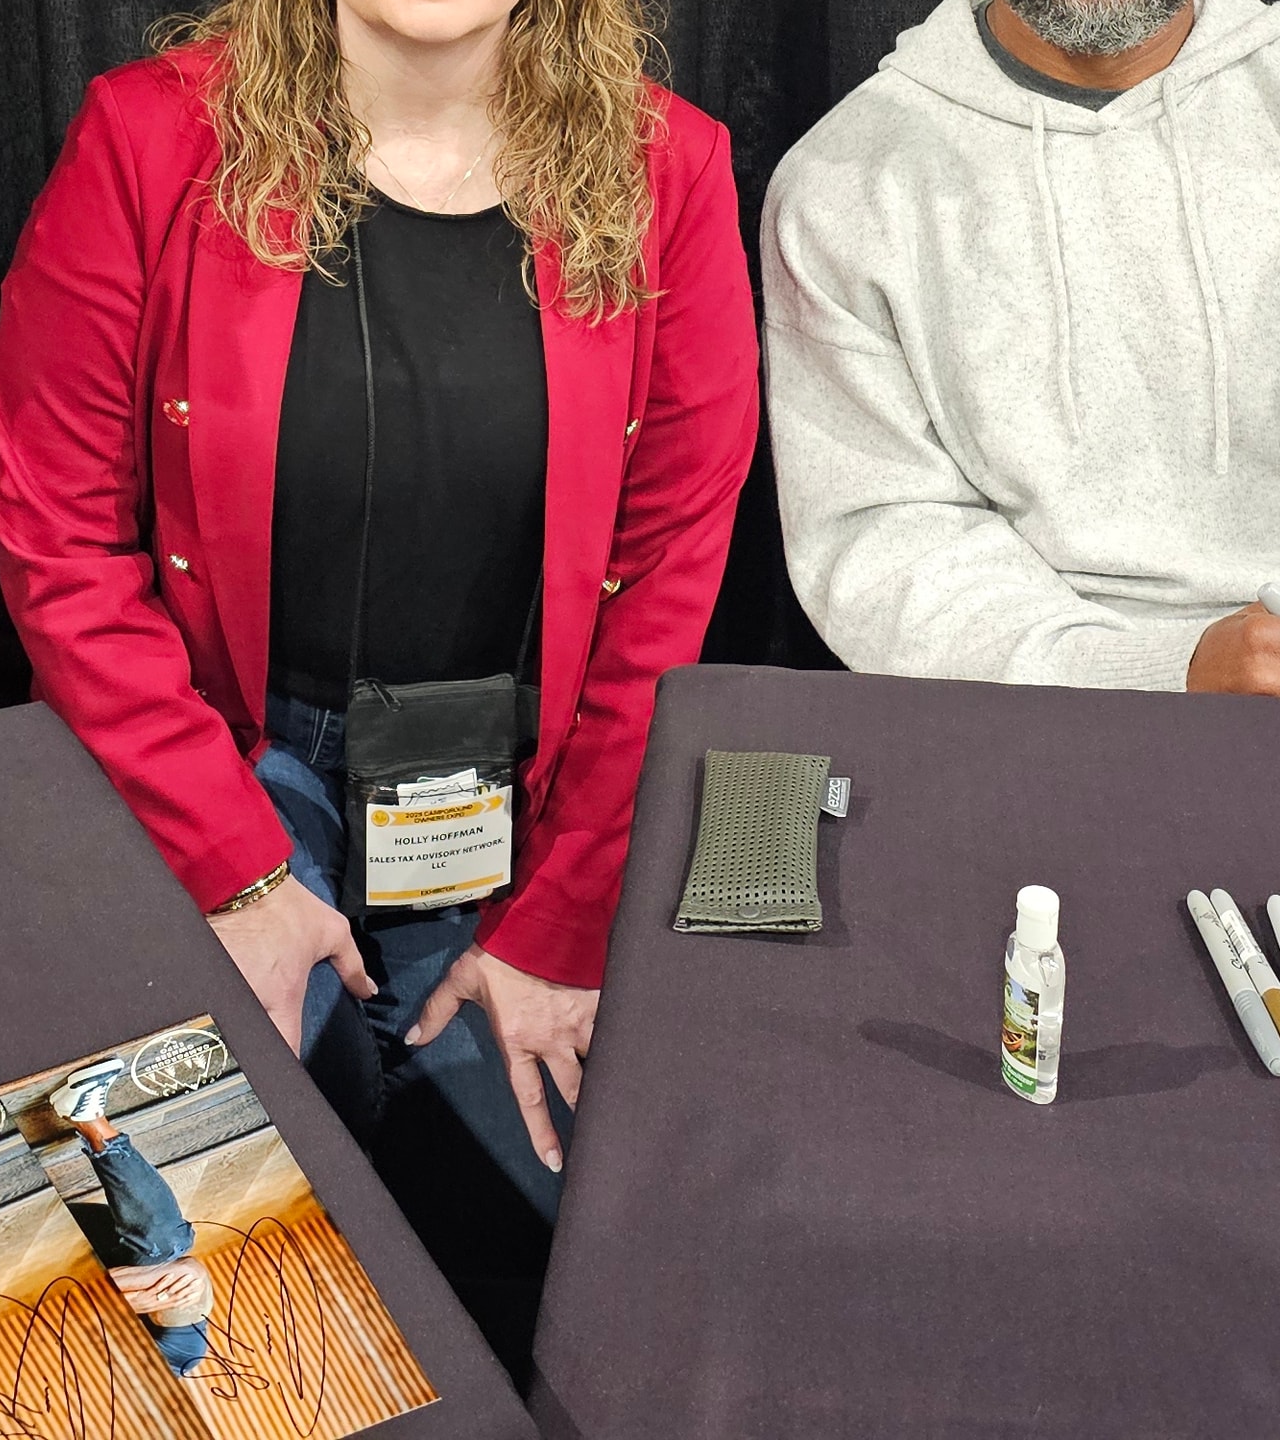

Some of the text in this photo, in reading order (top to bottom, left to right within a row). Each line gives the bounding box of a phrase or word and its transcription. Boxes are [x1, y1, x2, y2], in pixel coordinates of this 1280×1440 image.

[394, 826, 483, 846] HOLLY HOFFMAN
[369, 856, 396, 864] SALES
[398, 855, 414, 863] TAX
[416, 849, 460, 861] ADVISORY
